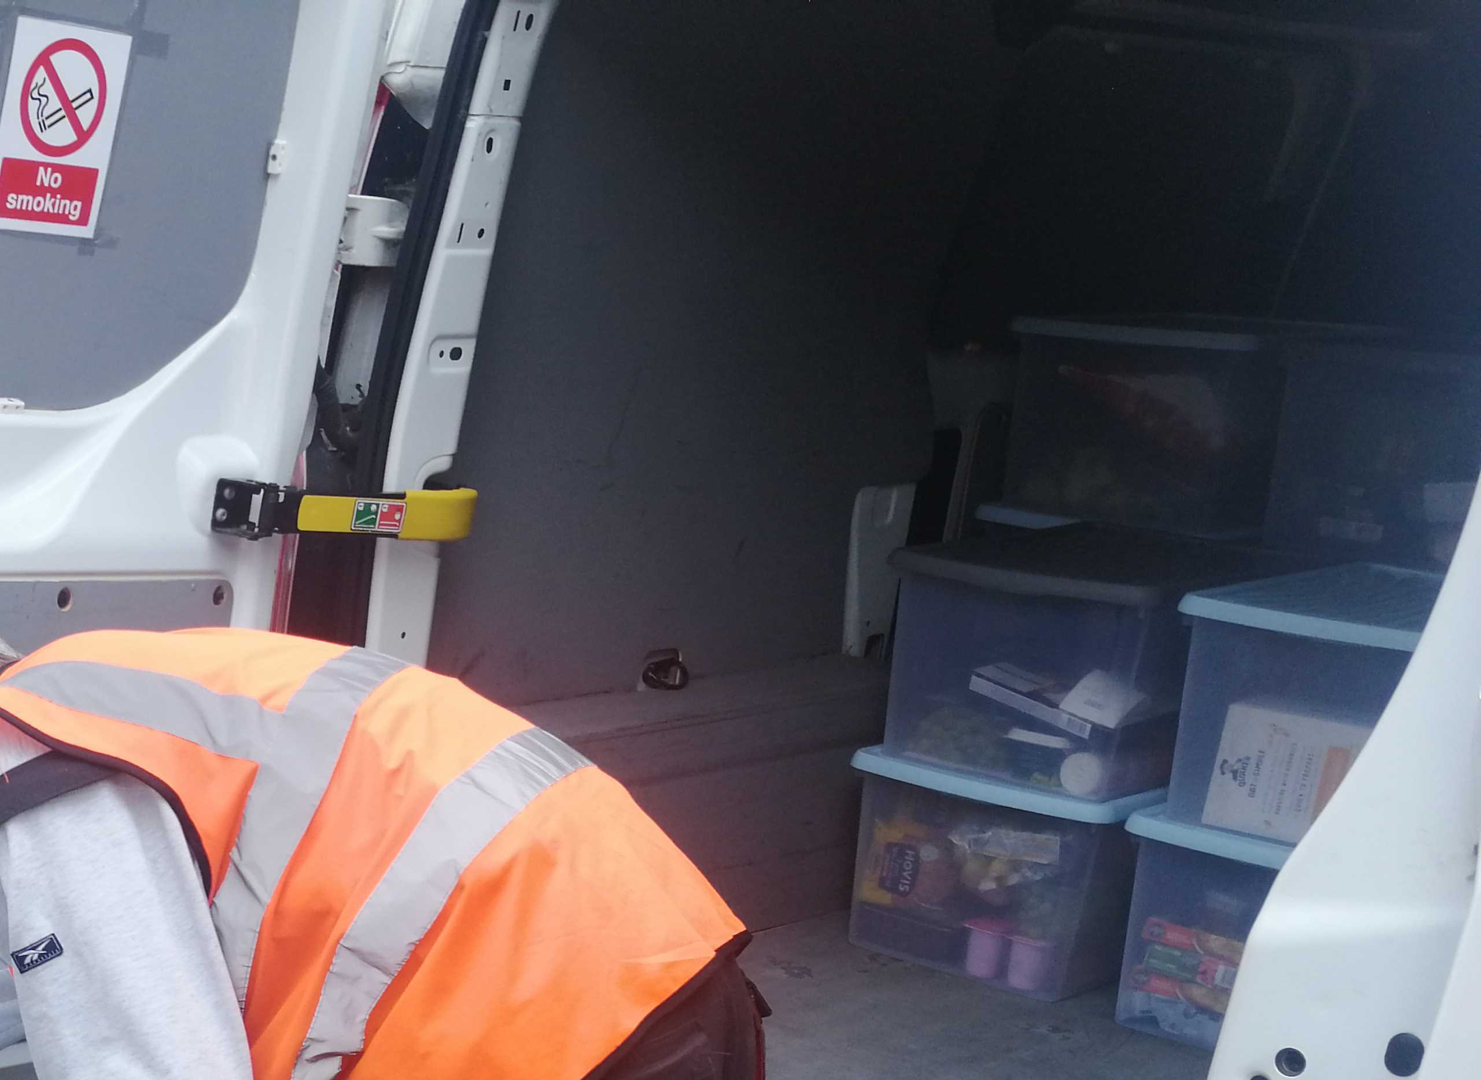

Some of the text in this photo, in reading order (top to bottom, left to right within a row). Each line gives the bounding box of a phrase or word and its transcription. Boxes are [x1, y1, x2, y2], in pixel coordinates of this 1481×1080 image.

[36, 166, 62, 188] No
[6, 193, 82, 221] smoking
[899, 850, 915, 892] HOVIS
